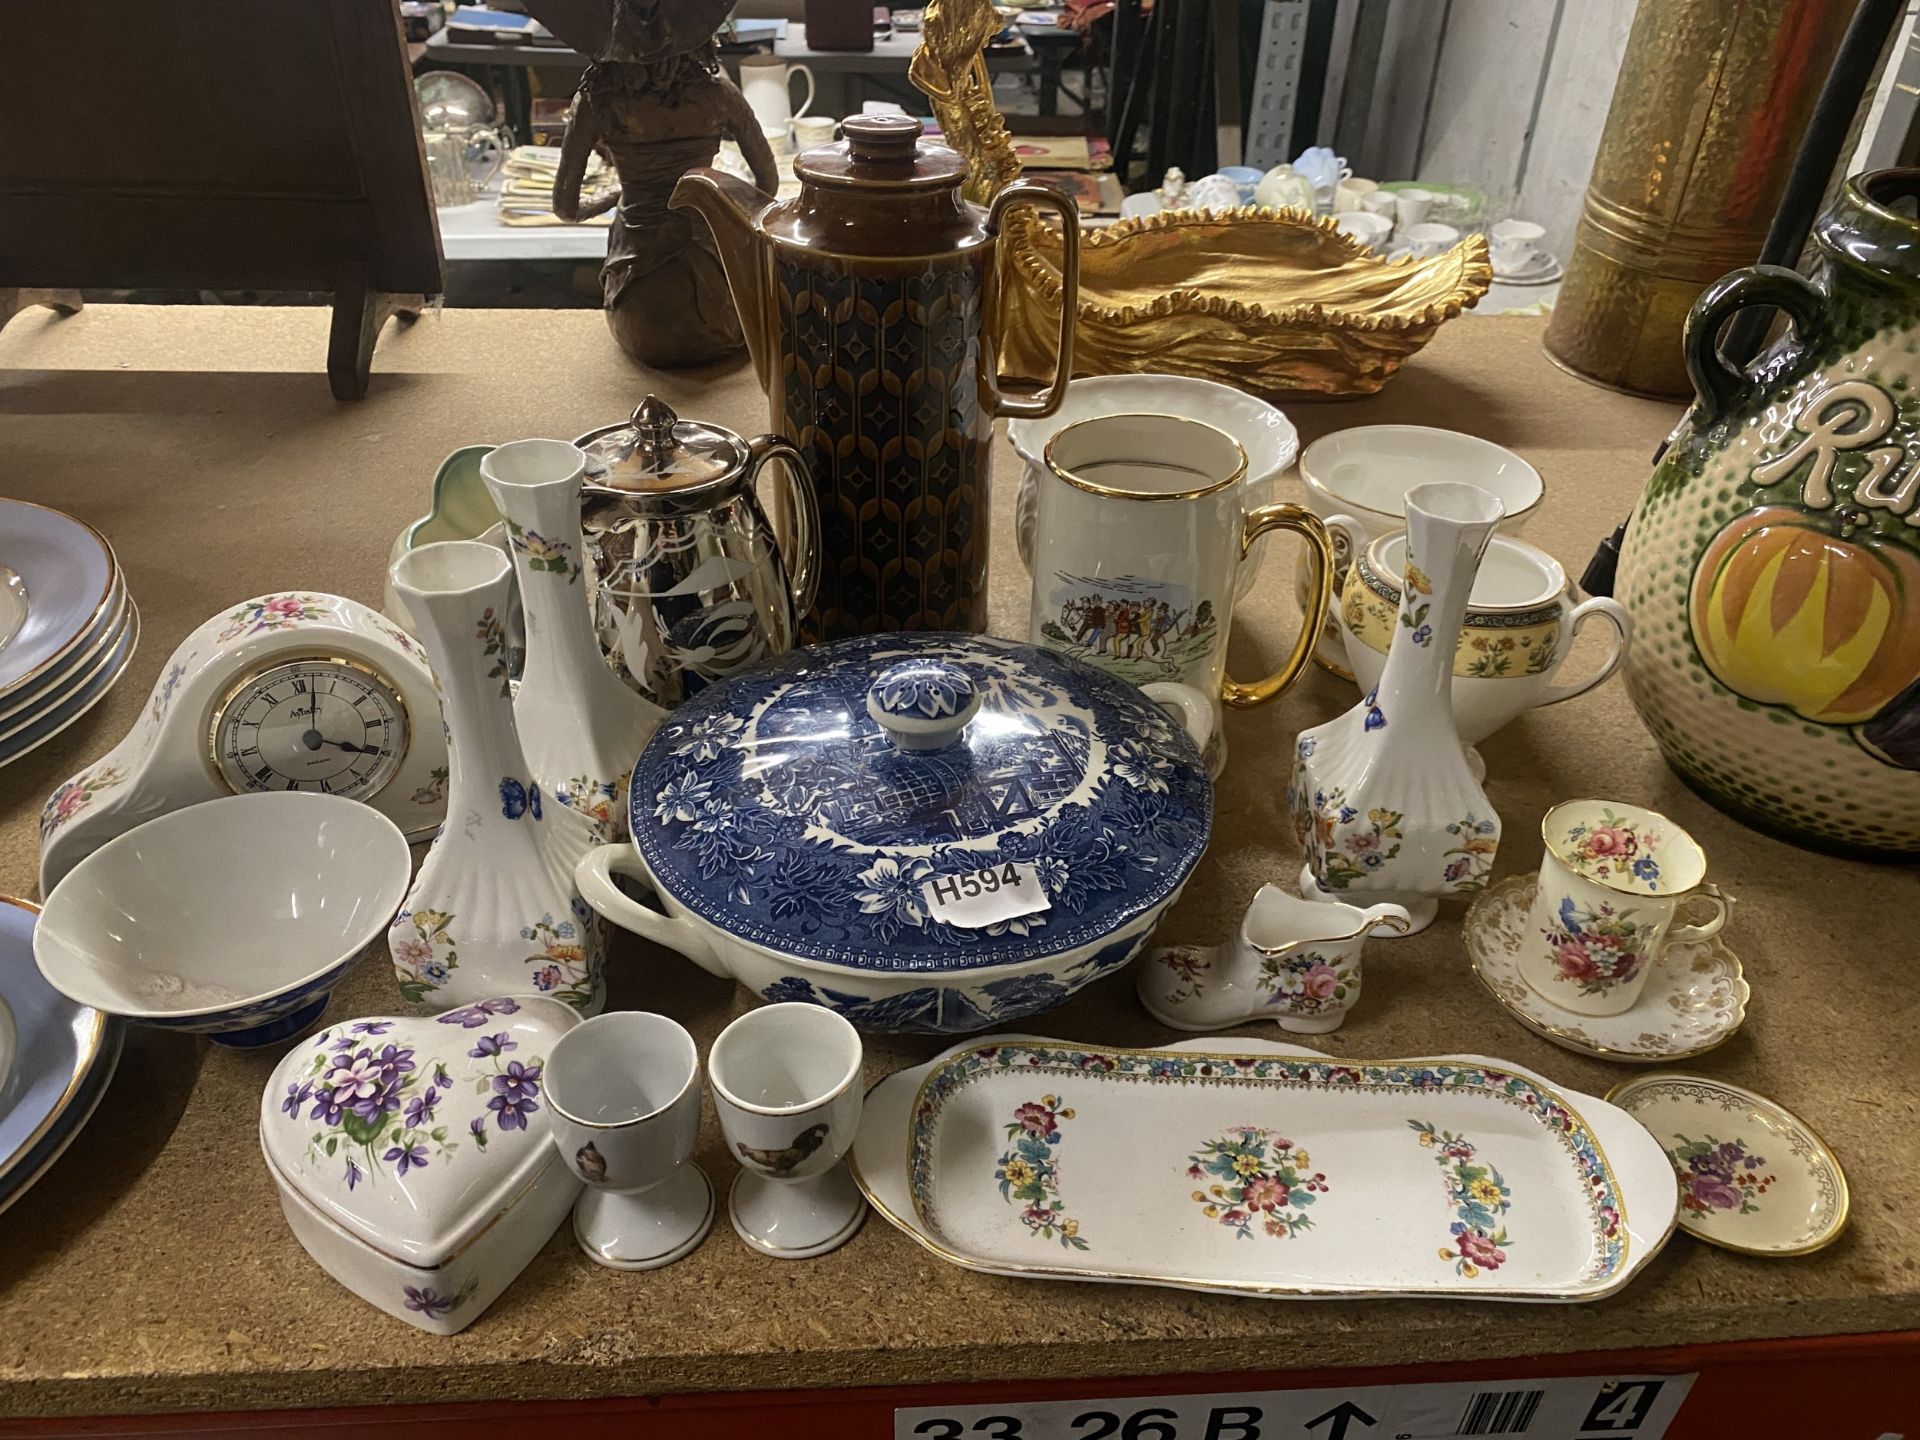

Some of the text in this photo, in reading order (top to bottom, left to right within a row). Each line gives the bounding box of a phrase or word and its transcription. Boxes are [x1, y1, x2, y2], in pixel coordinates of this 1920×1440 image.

[1751, 380, 1920, 526] Ru
[931, 862, 1022, 907] H594
[912, 1406, 1264, 1440] 33 26 B
[1595, 1384, 1647, 1429] 4
